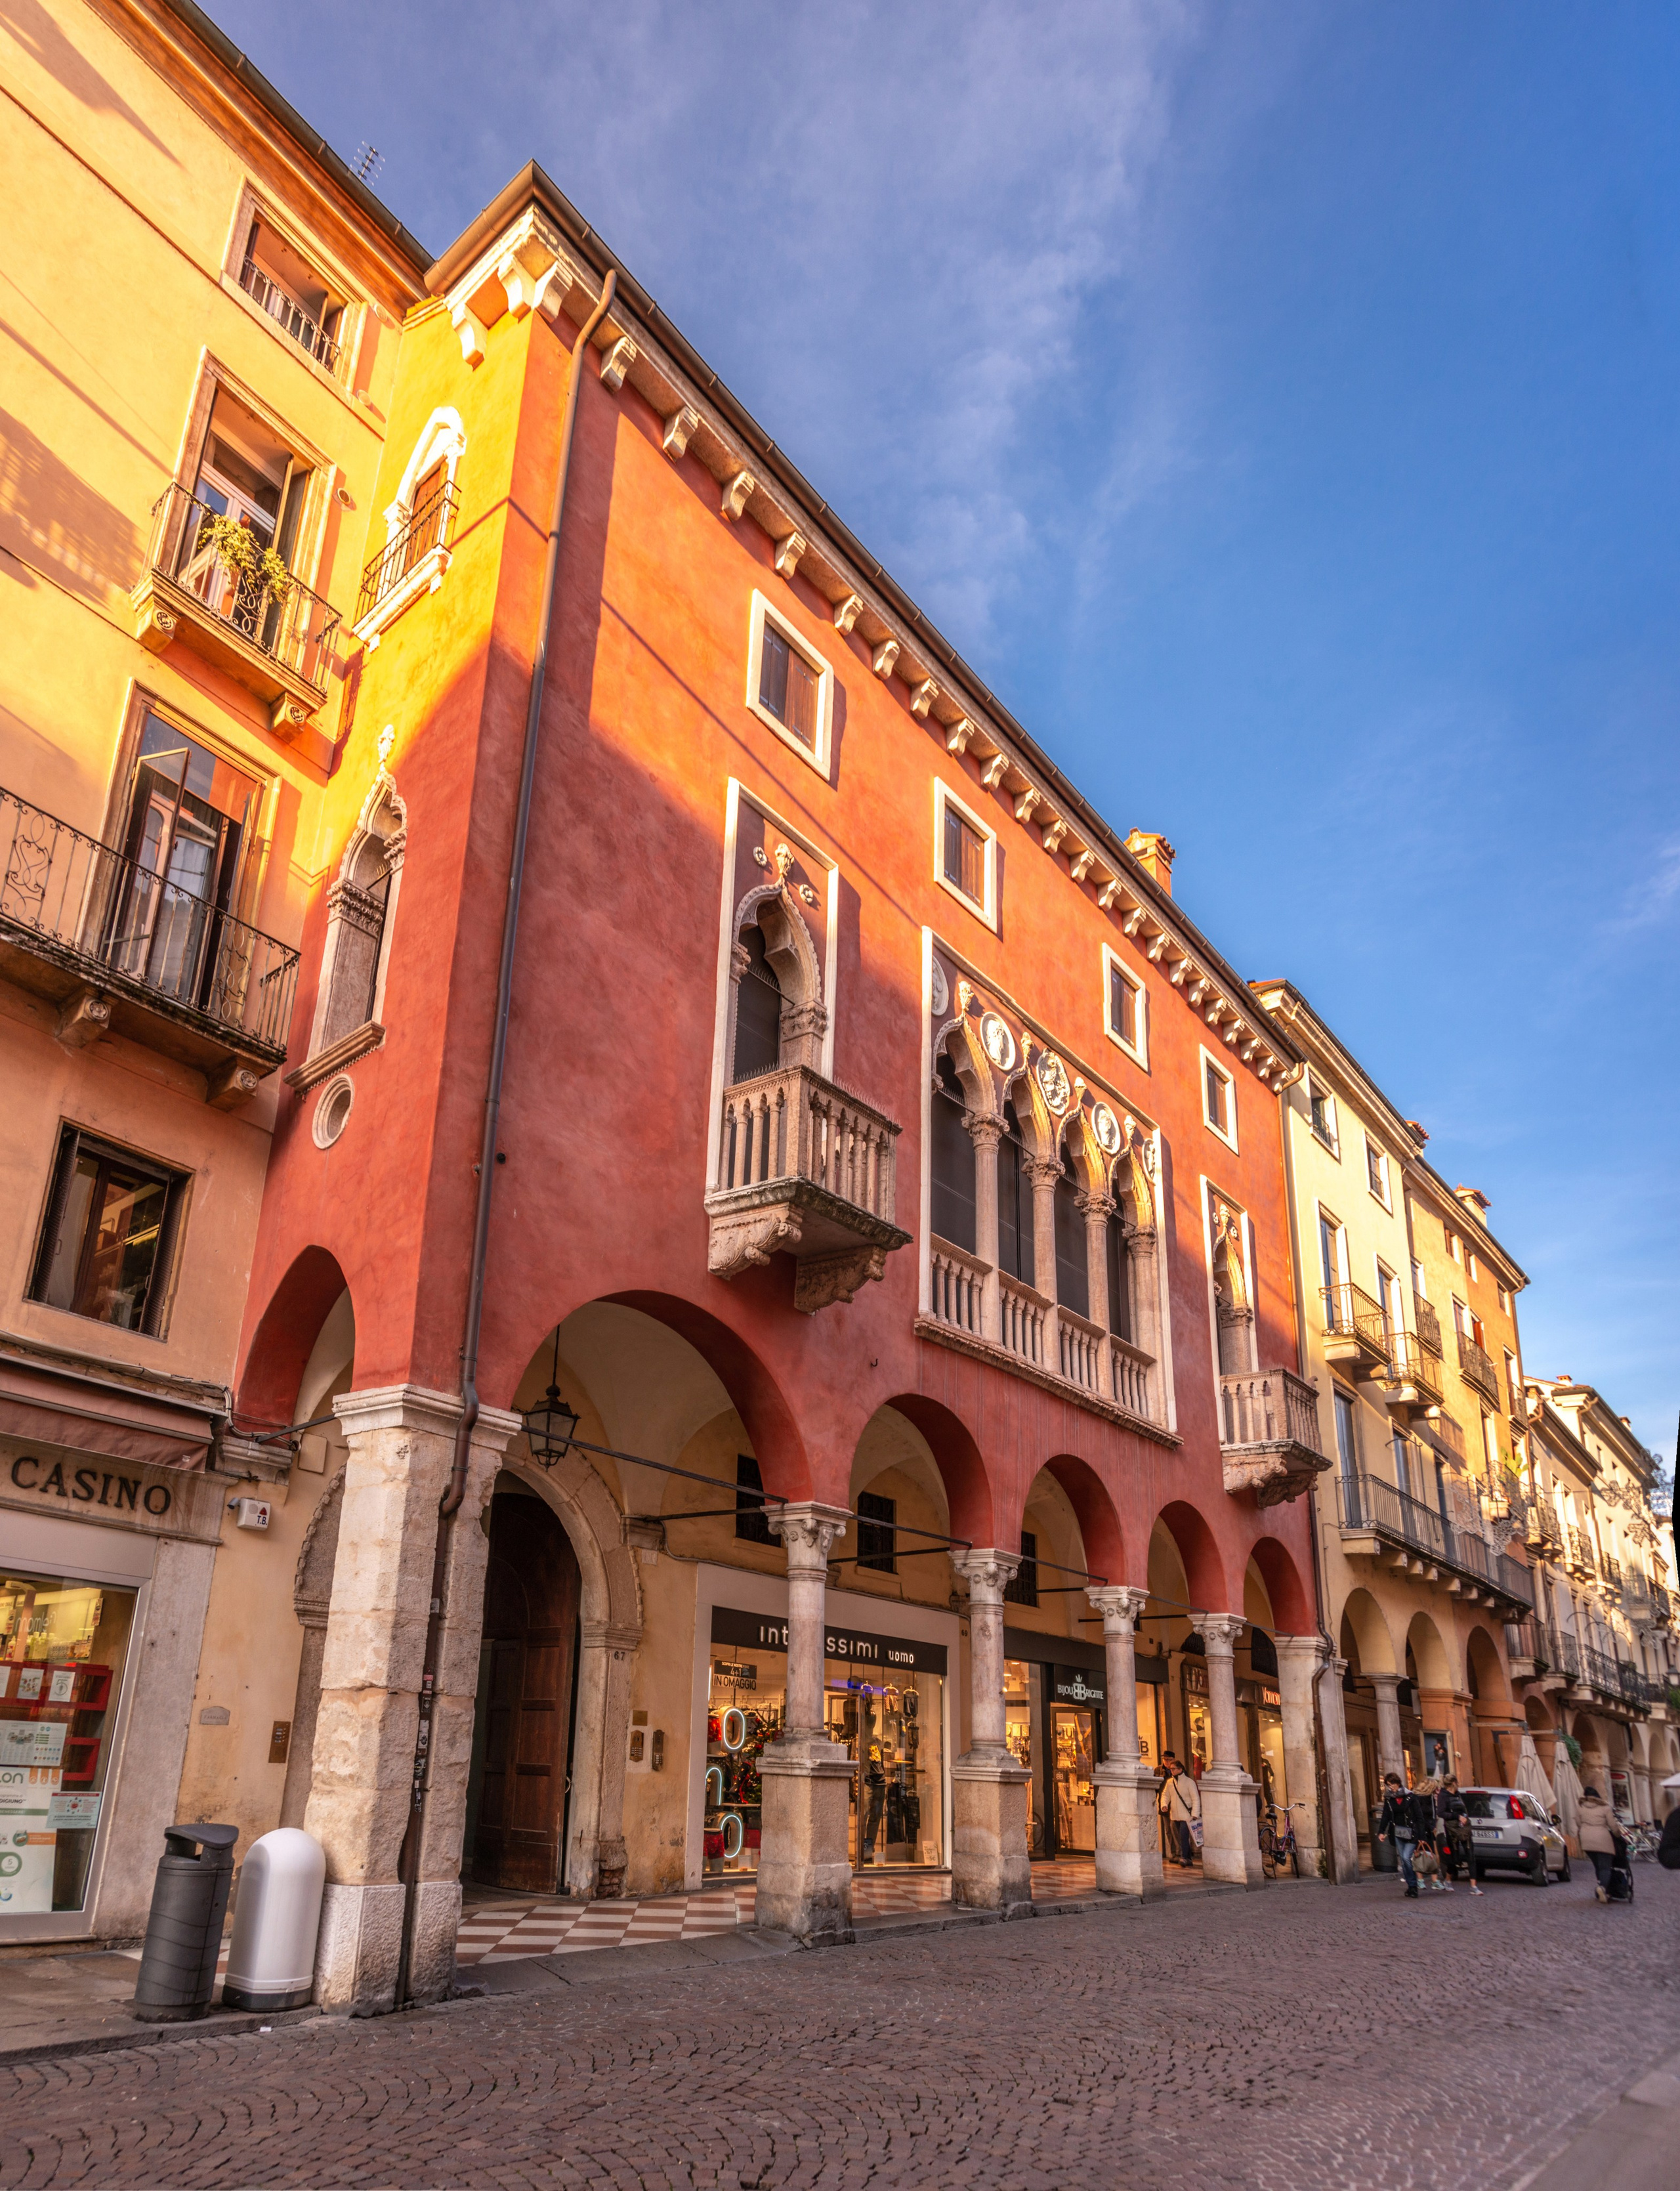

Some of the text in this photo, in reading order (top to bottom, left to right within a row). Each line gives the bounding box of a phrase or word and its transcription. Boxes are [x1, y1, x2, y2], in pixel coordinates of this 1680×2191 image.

[10, 1456, 172, 1515] CASINO
[257, 1515, 268, 1525] T.B.
[760, 1625, 914, 1664] intssimi uomo
[730, 1667, 742, 1677] 4+1
[714, 1674, 757, 1690] IN OMAGGIO
[1057, 1684, 1073, 1696] BIJOU
